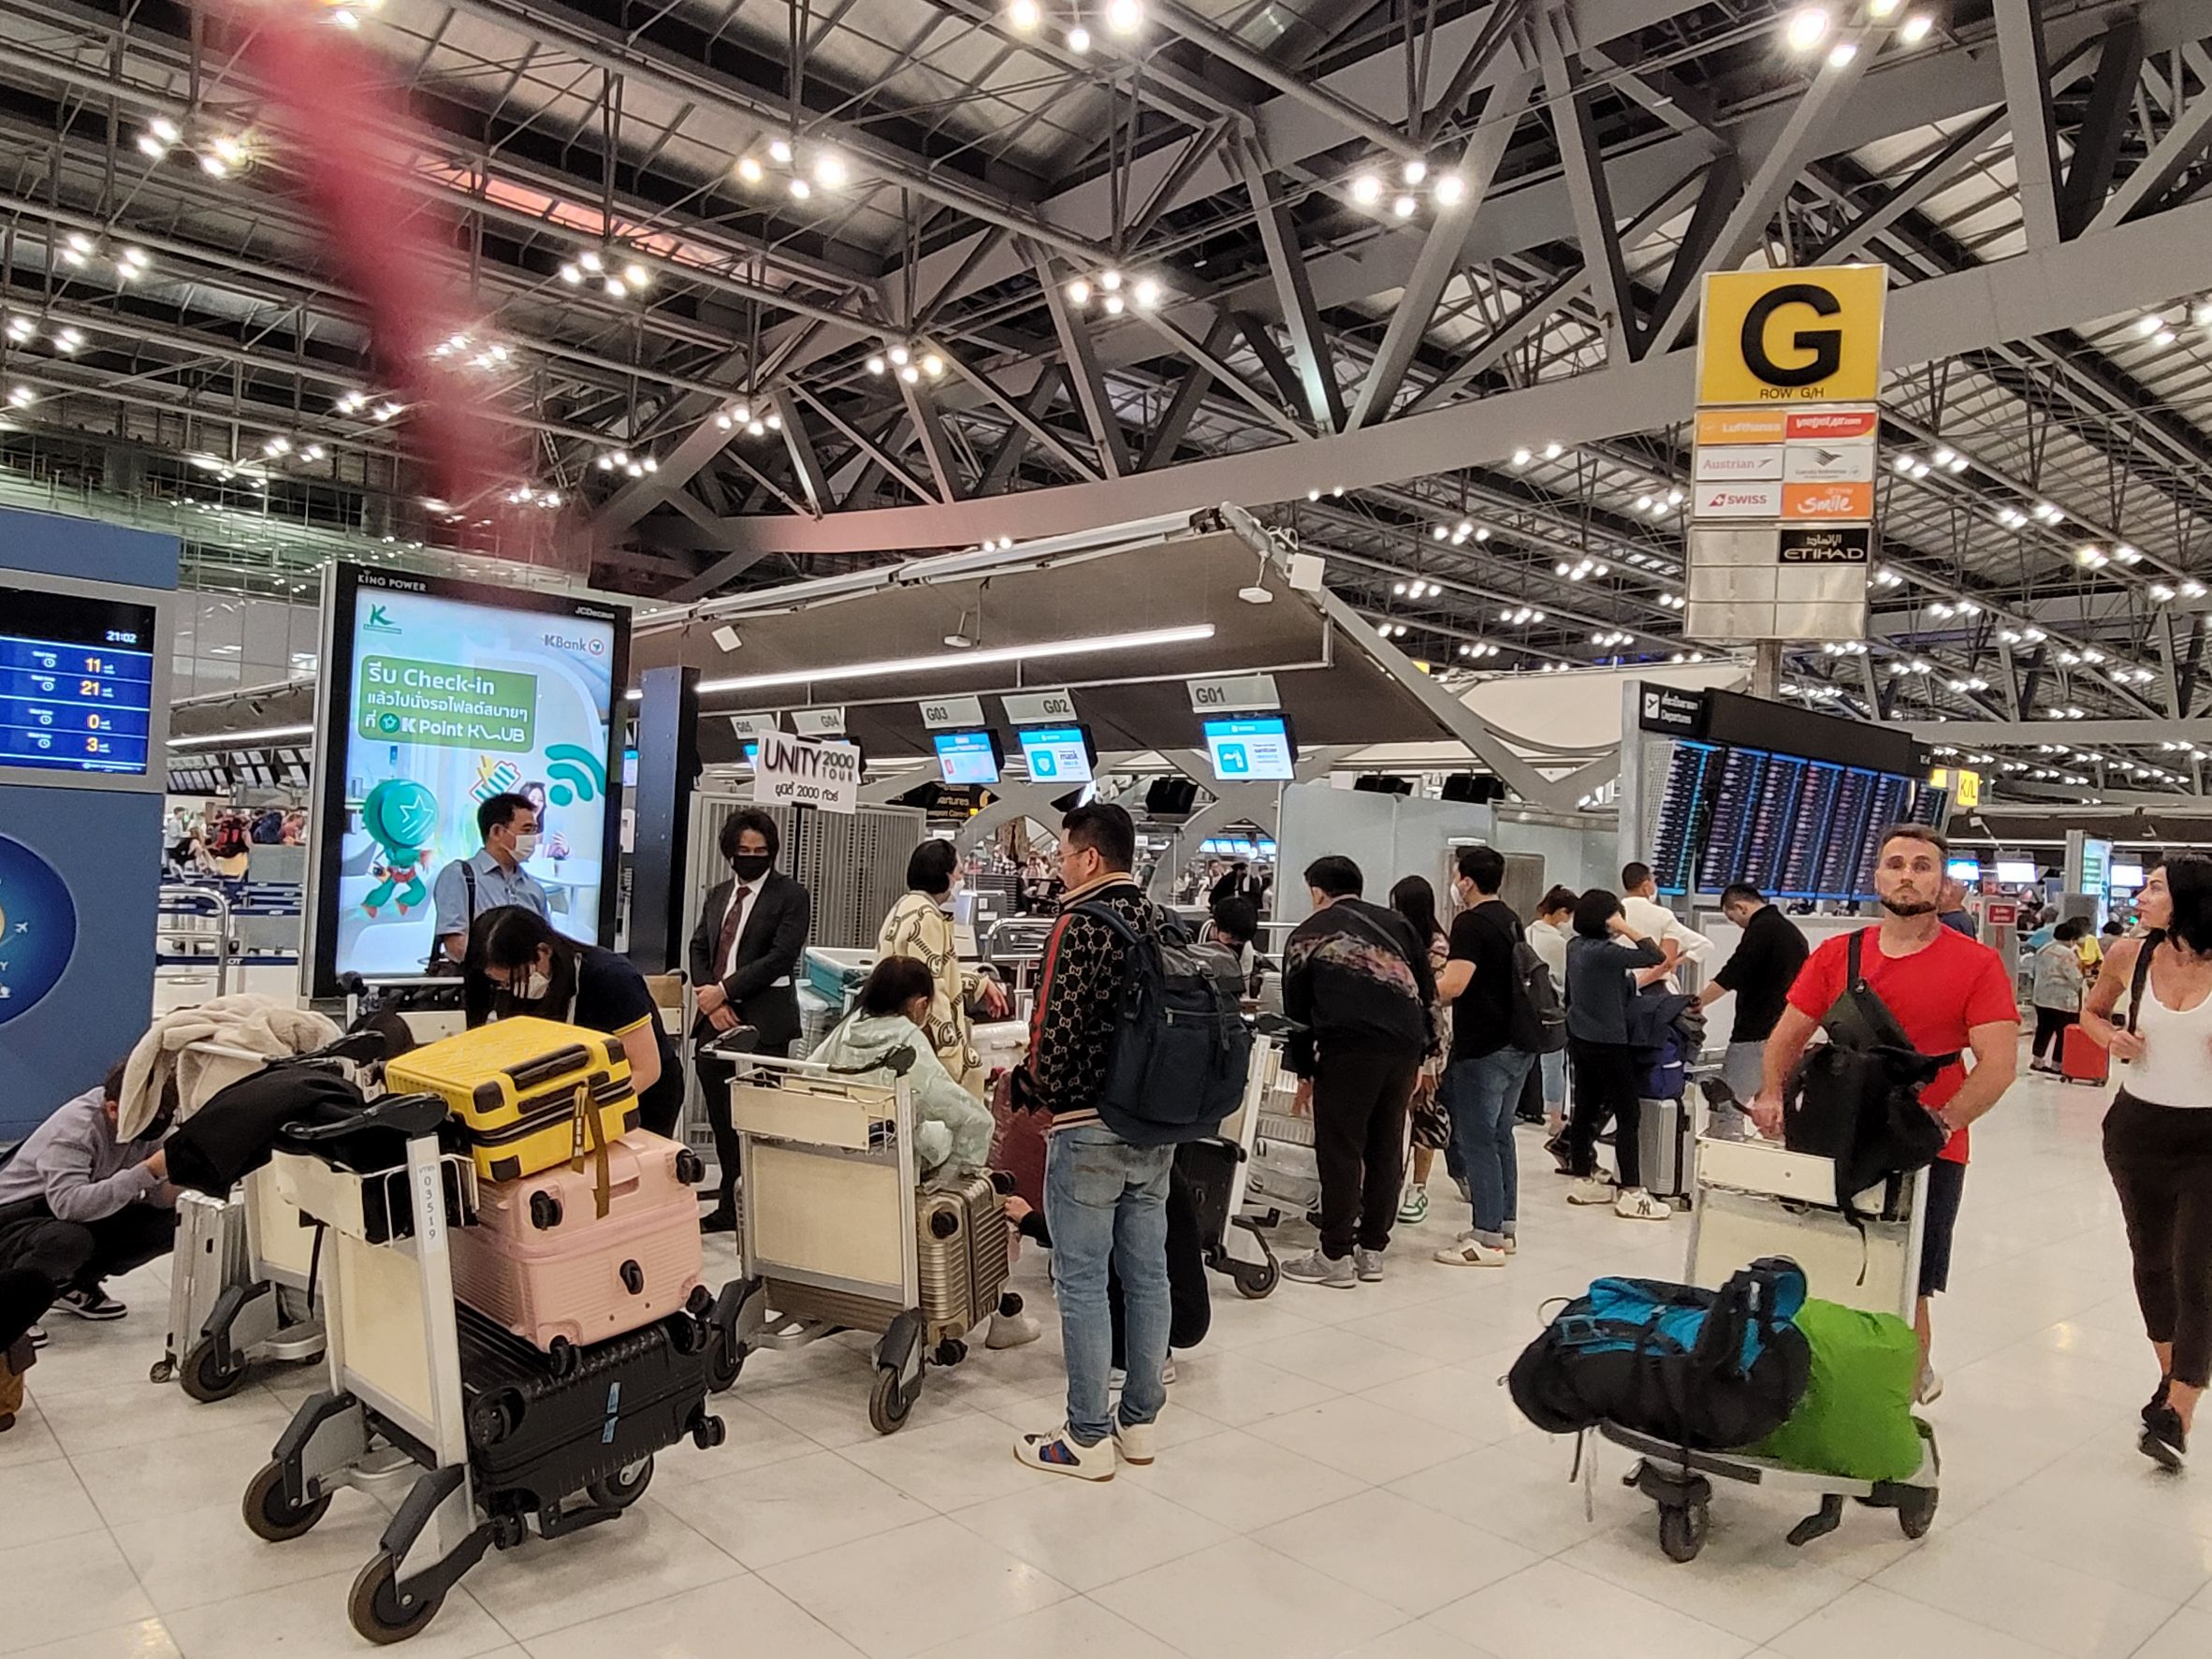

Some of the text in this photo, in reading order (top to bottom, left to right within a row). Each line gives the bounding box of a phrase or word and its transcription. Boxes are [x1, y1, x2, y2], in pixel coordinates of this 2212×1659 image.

[1741, 284, 1842, 386] G
[1759, 386, 1825, 400] ROW G/H
[1703, 458, 1755, 470] Austrian
[1727, 494, 1768, 505] SWISS
[1783, 547, 1865, 560] ETIHAD
[357, 570, 427, 592] KING POWER
[106, 631, 137, 643] 21:02
[85, 657, 102, 673] 11
[80, 680, 100, 696] 21
[402, 668, 495, 695] Check-in
[1196, 687, 1226, 704] G01
[925, 706, 948, 721] G03
[1043, 698, 1070, 714] G02
[419, 720, 464, 737] Point
[86, 736, 99, 752] 3
[764, 737, 822, 779] UNITY
[822, 750, 854, 769] 2000
[796, 784, 821, 800] 2000
